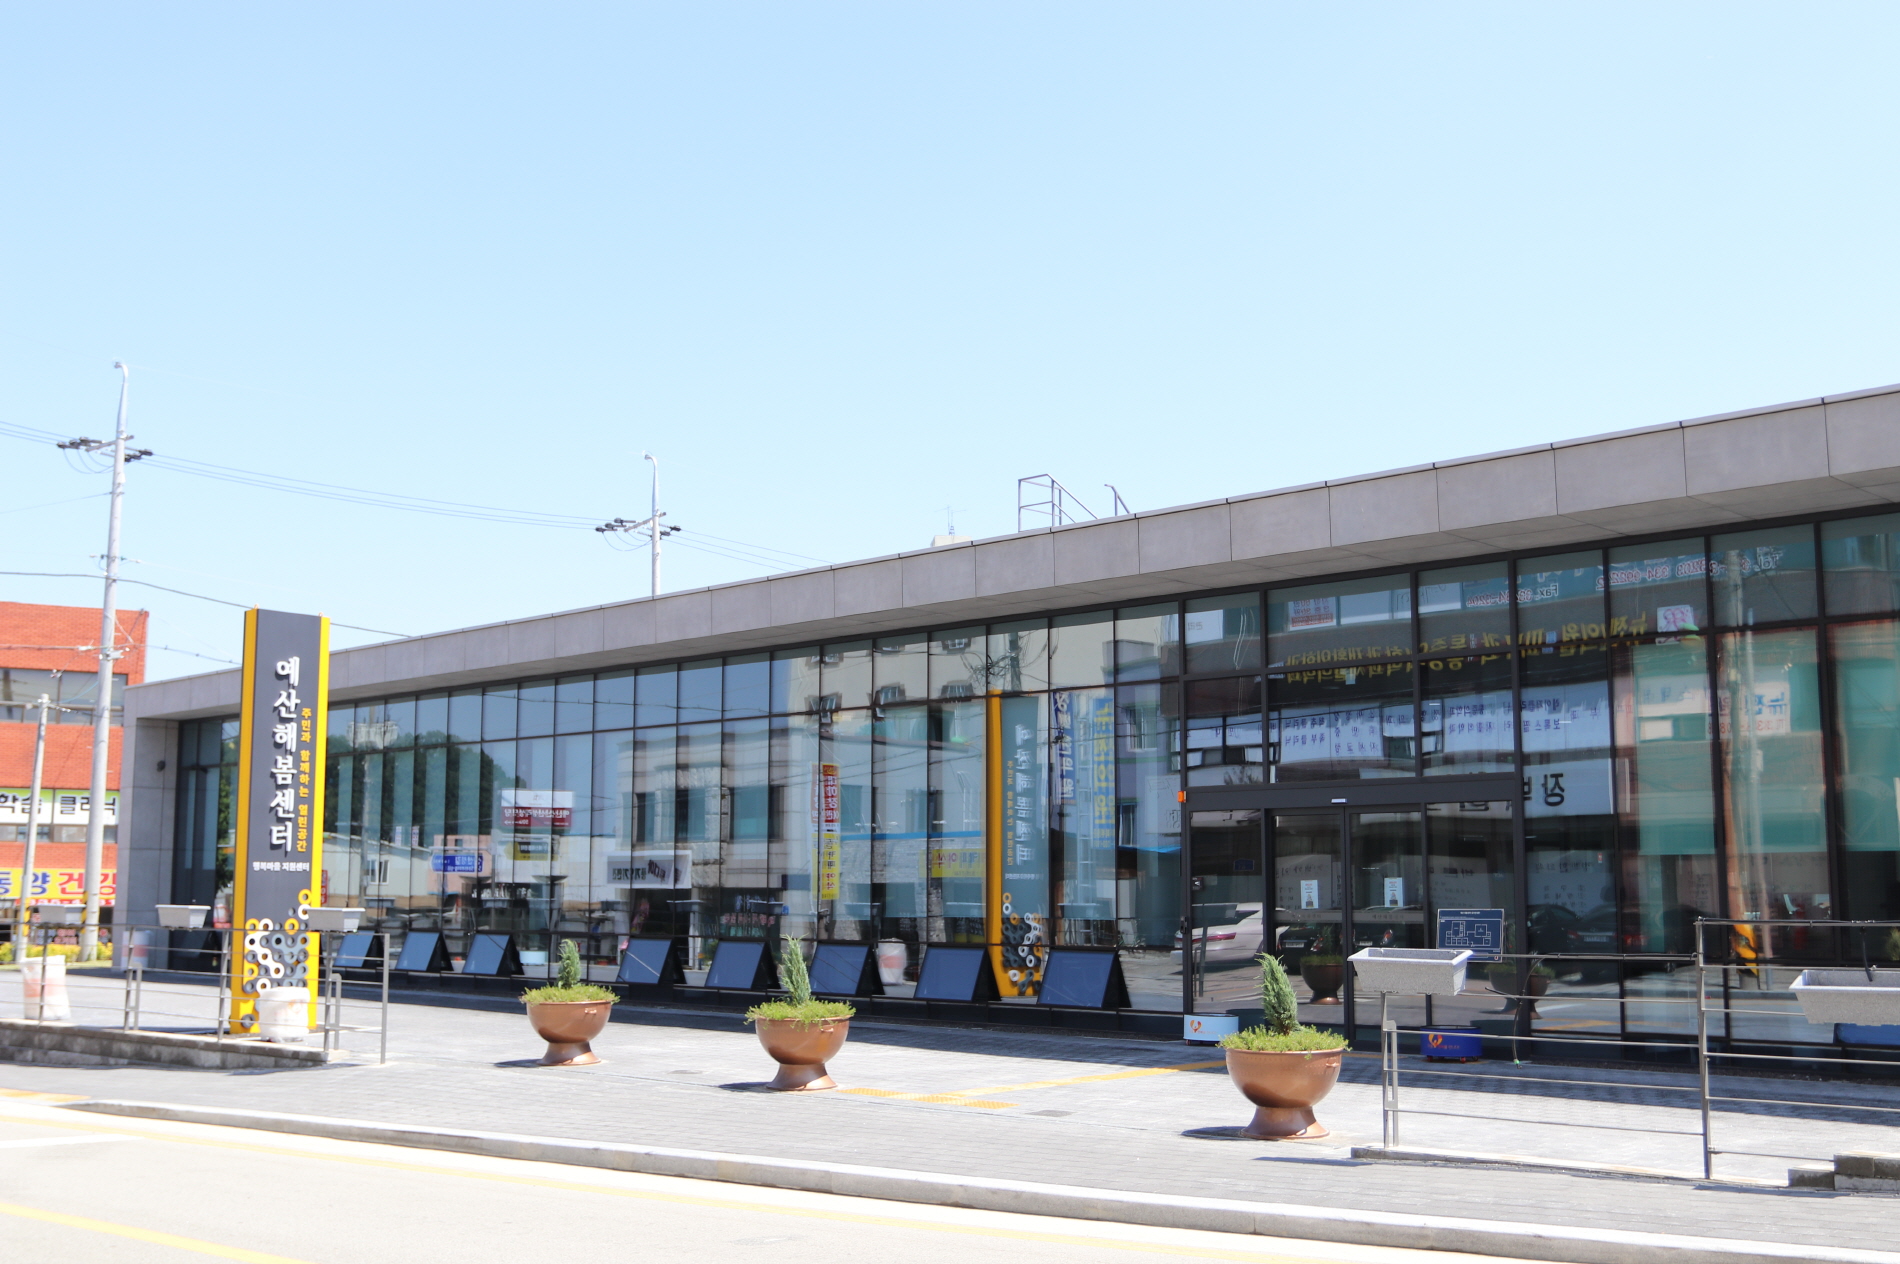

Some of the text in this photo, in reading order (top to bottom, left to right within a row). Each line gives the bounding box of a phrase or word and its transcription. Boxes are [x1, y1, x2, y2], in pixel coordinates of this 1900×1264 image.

[270, 656, 300, 852] 예산해봄센터
[297, 707, 312, 852] 주민과 함께하는 열린공간
[252, 861, 310, 872] 행복마을 지원센터
